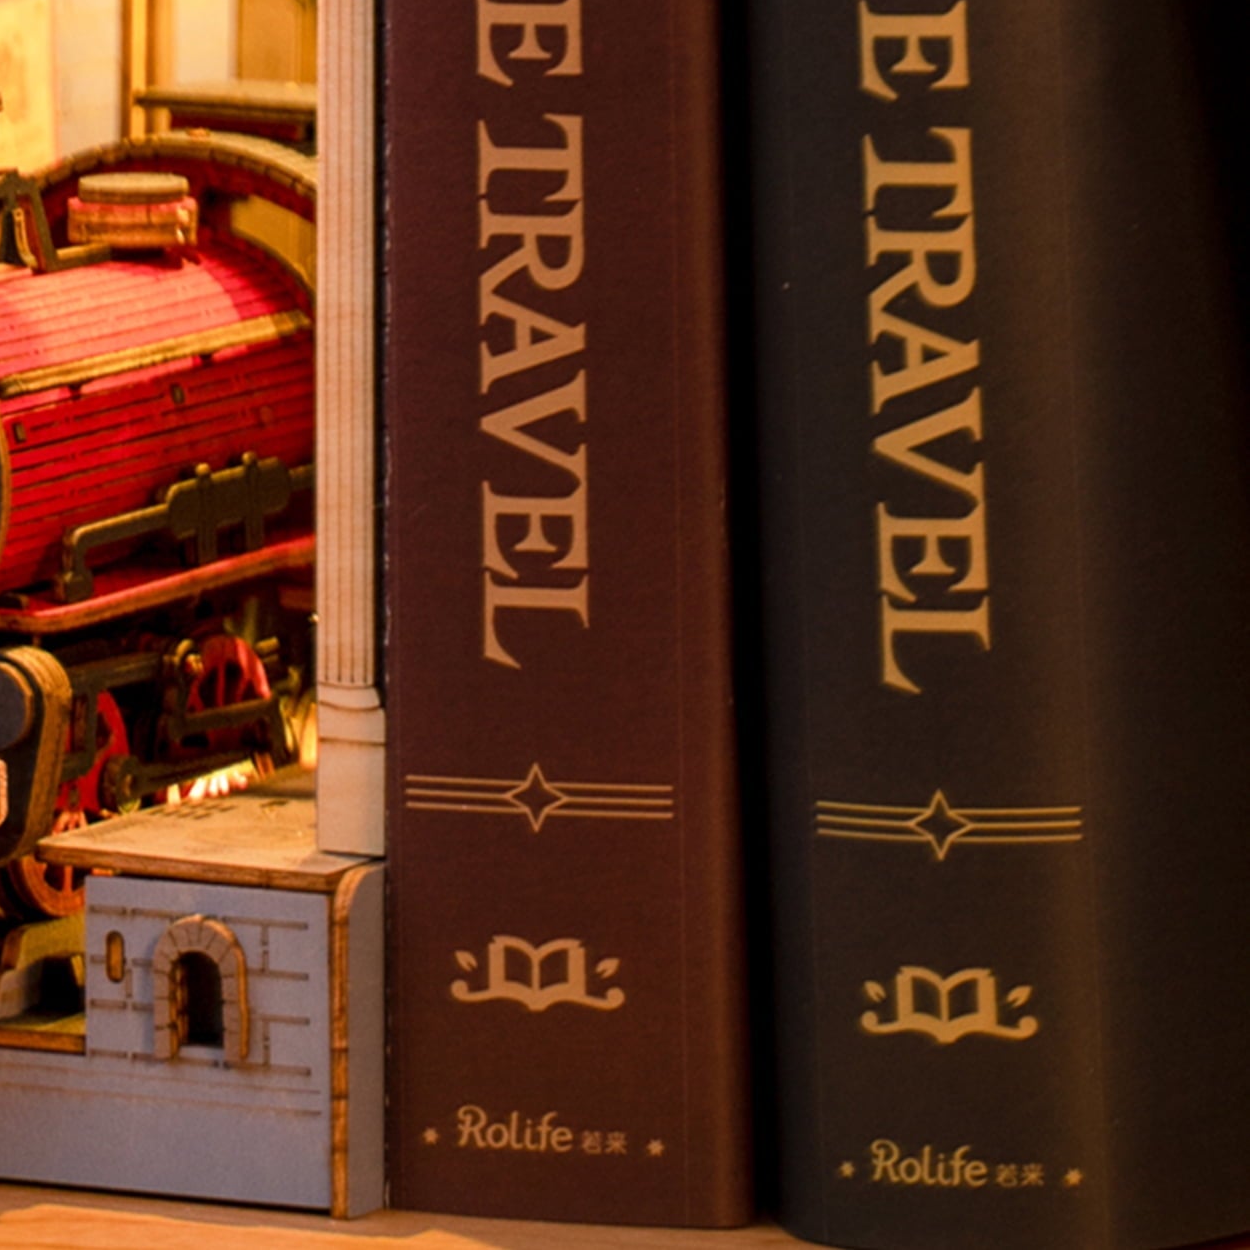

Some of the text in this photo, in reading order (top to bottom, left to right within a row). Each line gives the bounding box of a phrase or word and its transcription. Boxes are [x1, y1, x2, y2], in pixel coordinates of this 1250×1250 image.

[477, 114, 590, 669] TRAVEL
[862, 126, 991, 694] TRAVEL
[457, 1105, 573, 1152] Rolife
[870, 1139, 988, 1187] Rolife
